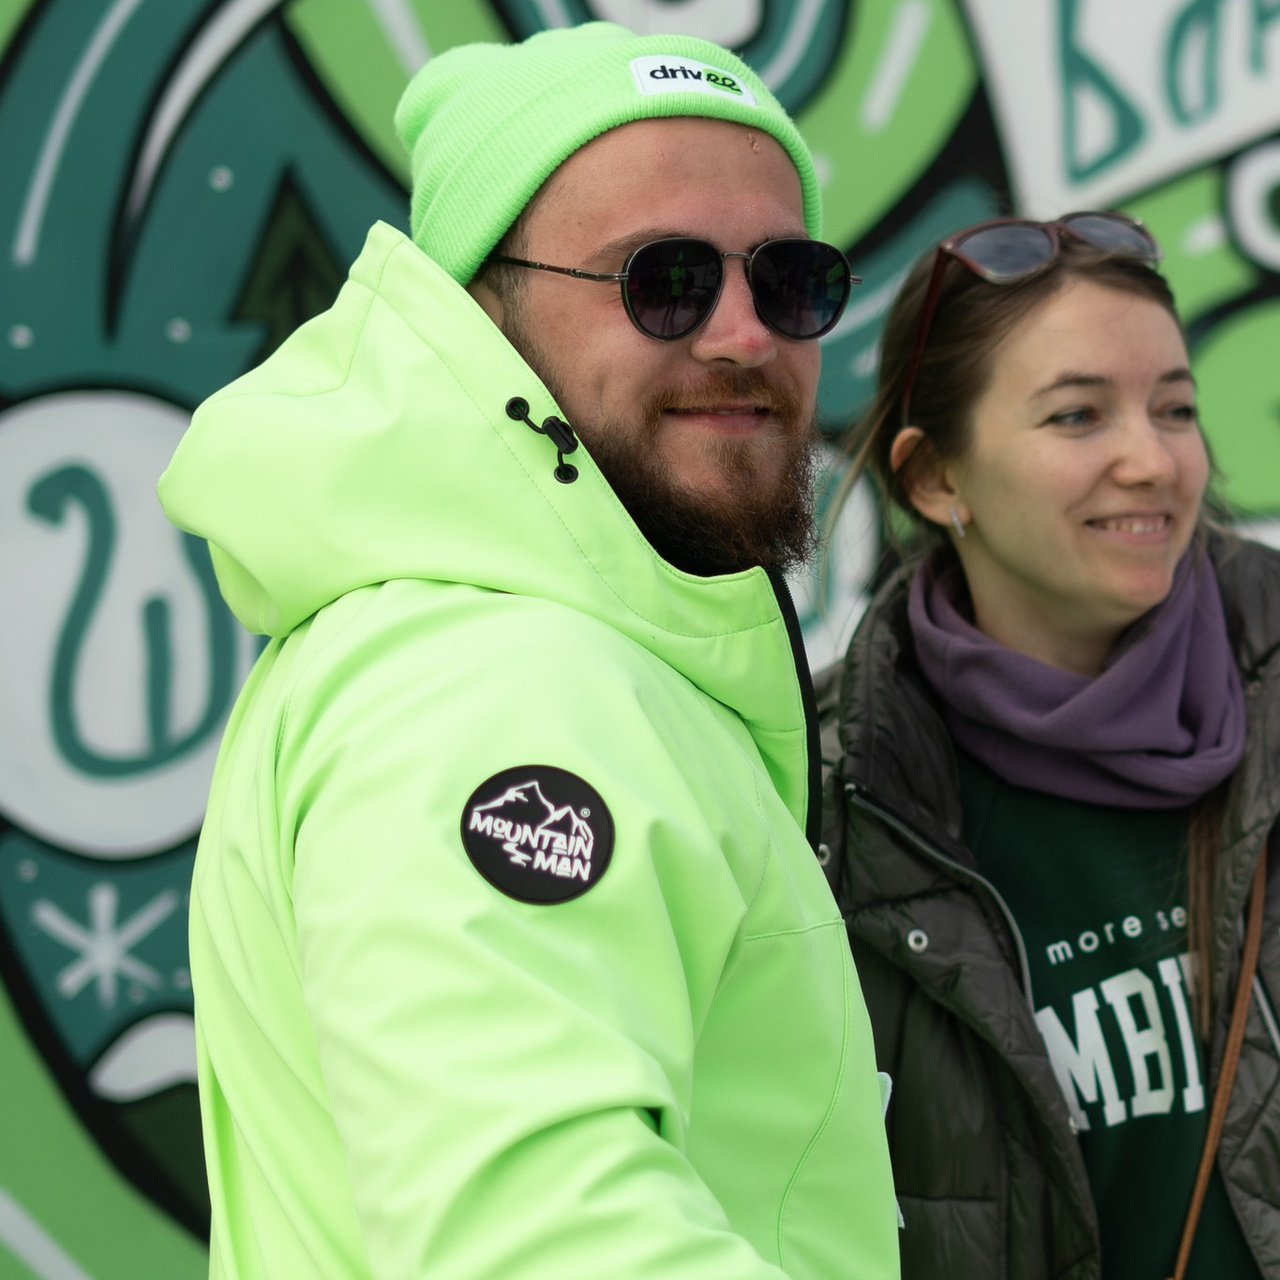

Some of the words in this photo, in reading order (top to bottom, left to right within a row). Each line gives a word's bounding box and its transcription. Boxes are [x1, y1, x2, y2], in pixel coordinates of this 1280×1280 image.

[649, 64, 743, 94] drivee
[469, 811, 594, 860] MOUNTAIN
[533, 850, 592, 882] MAN
[1046, 915, 1143, 966] more
